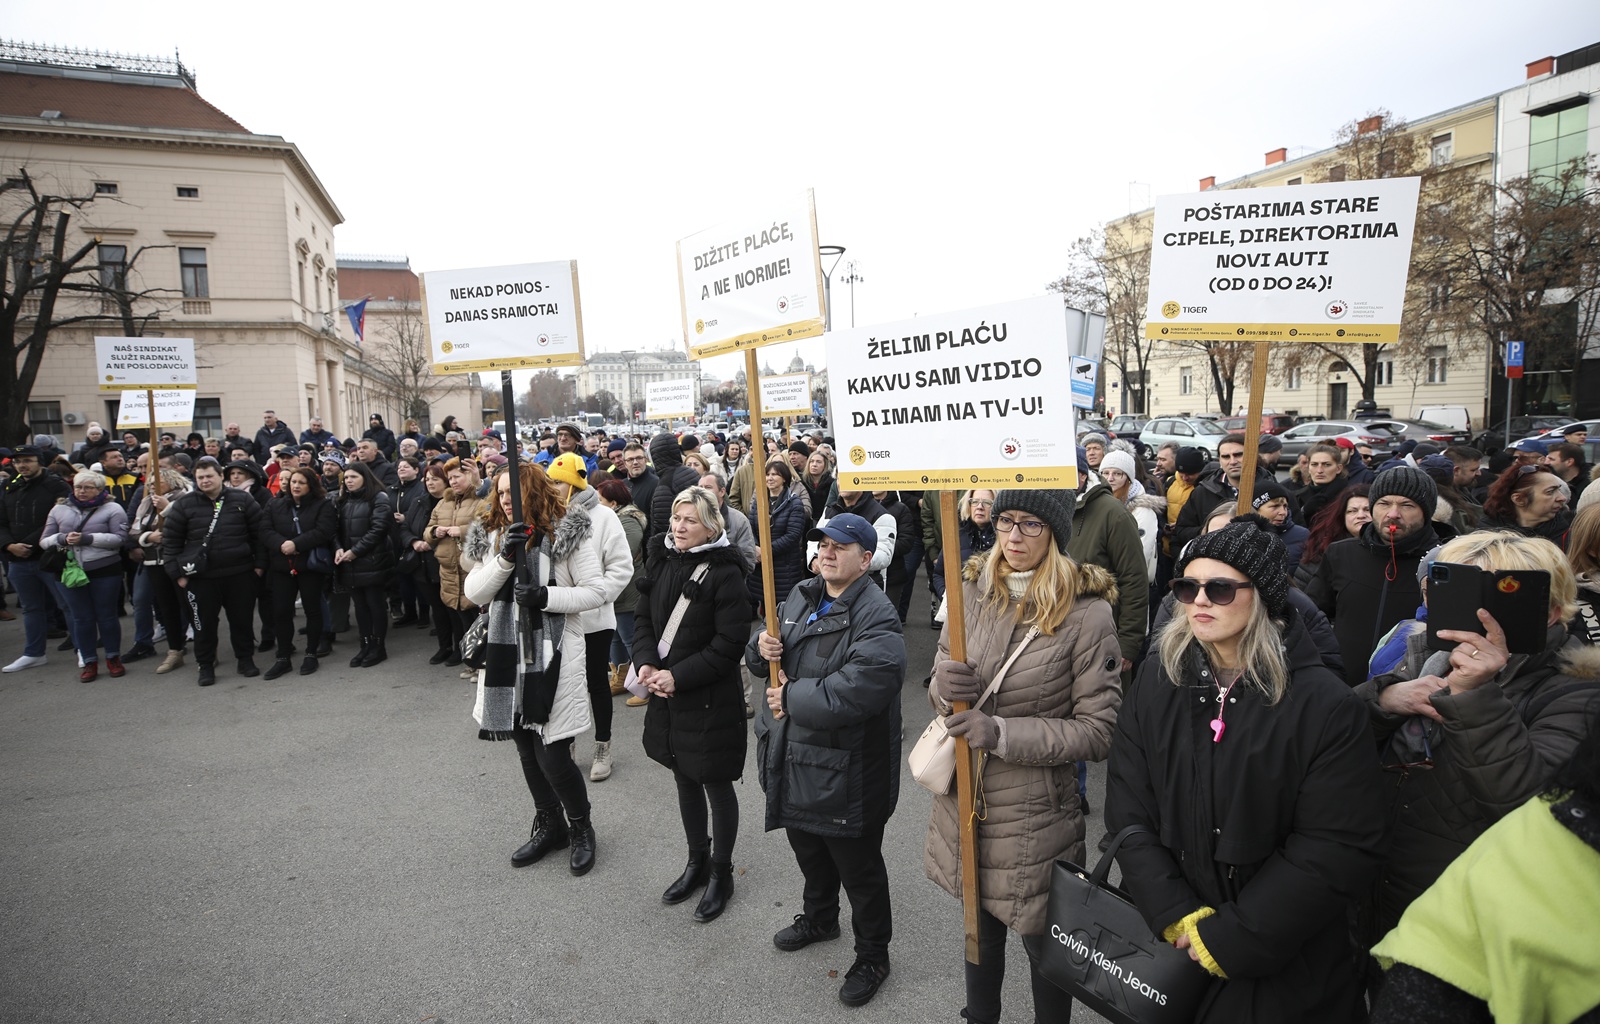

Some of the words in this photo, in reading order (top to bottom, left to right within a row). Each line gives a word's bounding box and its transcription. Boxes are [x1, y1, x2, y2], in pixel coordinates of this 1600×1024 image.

[1184, 202, 1305, 222] POŠTARIMA
[1310, 196, 1380, 215] STARE
[694, 240, 740, 271] DIŽITE
[744, 222, 794, 252] PLAĆE,
[1163, 230, 1234, 248] CIPELE,
[1239, 222, 1398, 244] DIREKTORIMA
[1216, 253, 1271, 268] NOVI
[1274, 251, 1329, 267] AUTI
[450, 285, 494, 300] NEKAD
[496, 281, 542, 296] PONOS
[701, 284, 710, 300] A
[714, 277, 730, 296] NE
[735, 258, 791, 290] NORME!
[1209, 277, 1244, 294] (OD
[1249, 278, 1259, 291] 0
[1263, 276, 1292, 290] DO
[1296, 274, 1332, 292] 24)!
[445, 308, 488, 324] DANAS
[491, 303, 558, 320] SRAMOTA!
[705, 320, 718, 328] TIGER
[867, 334, 931, 359] ŽELIM
[936, 320, 1007, 350] PLAĆU
[1511, 342, 1520, 359] P
[847, 372, 910, 395] KAKVU
[915, 366, 960, 388] SAM
[965, 358, 1042, 382] VIDIO
[852, 410, 878, 428] DA
[882, 404, 942, 425] IMAM
[946, 402, 977, 420] NA
[980, 396, 1044, 418] TV-U!
[868, 451, 890, 459] TIGER
[1050, 924, 1089, 959] Calvin
[1090, 949, 1122, 979] Klein
[1123, 971, 1168, 1006] Jeans
